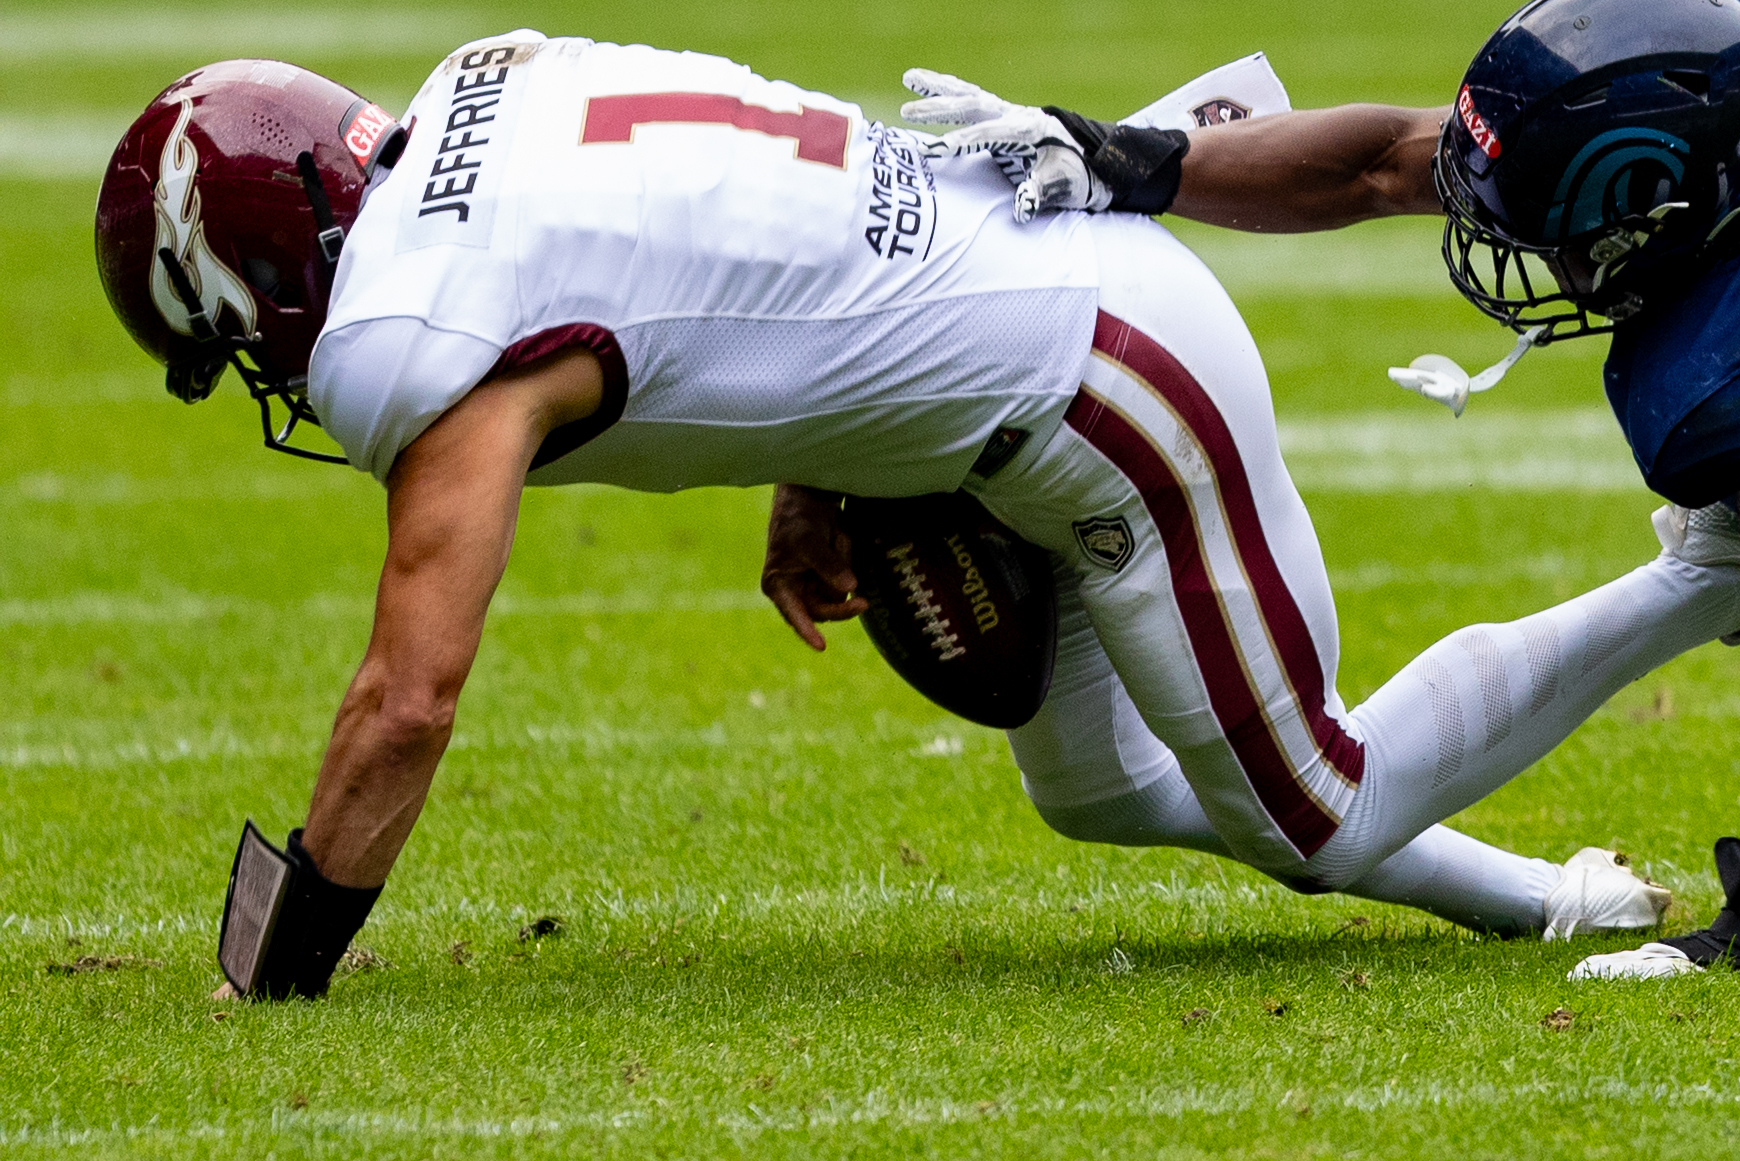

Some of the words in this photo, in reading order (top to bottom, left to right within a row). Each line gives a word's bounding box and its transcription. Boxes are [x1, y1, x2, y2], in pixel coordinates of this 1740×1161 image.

[418, 46, 516, 223] JEFFRIES
[577, 90, 852, 172] 1
[947, 536, 999, 635] Wilson
